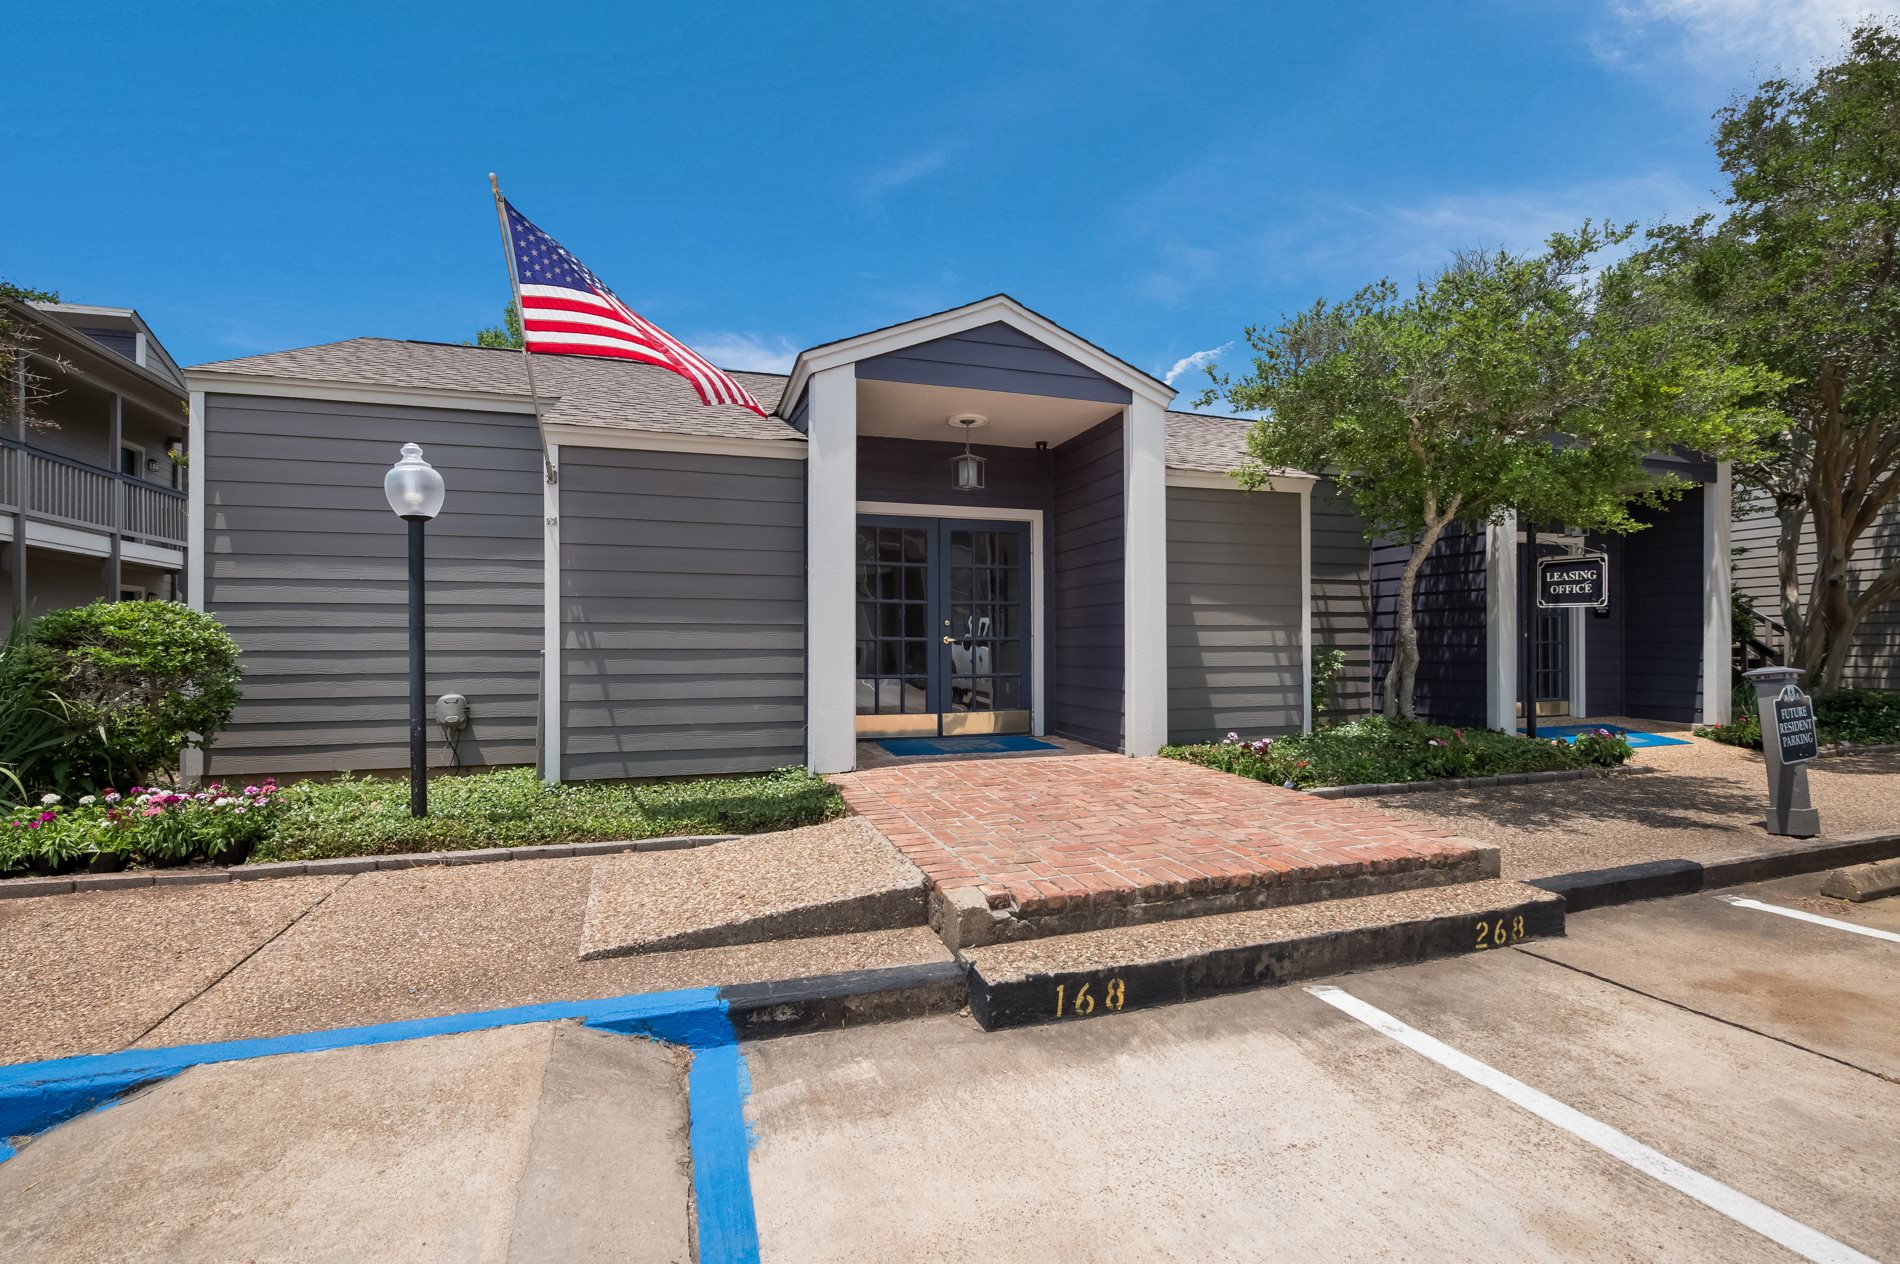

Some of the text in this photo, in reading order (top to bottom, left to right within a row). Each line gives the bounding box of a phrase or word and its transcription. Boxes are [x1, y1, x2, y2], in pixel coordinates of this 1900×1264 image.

[1546, 570, 1597, 581] LEASING
[1550, 583, 1592, 594] OFFICE
[1781, 706, 1807, 719] FUTURE
[1779, 719, 1812, 733] RESIDENT
[1782, 733, 1813, 747] PARKING
[1475, 915, 1524, 948] 268
[1057, 979, 1126, 1017] 168
